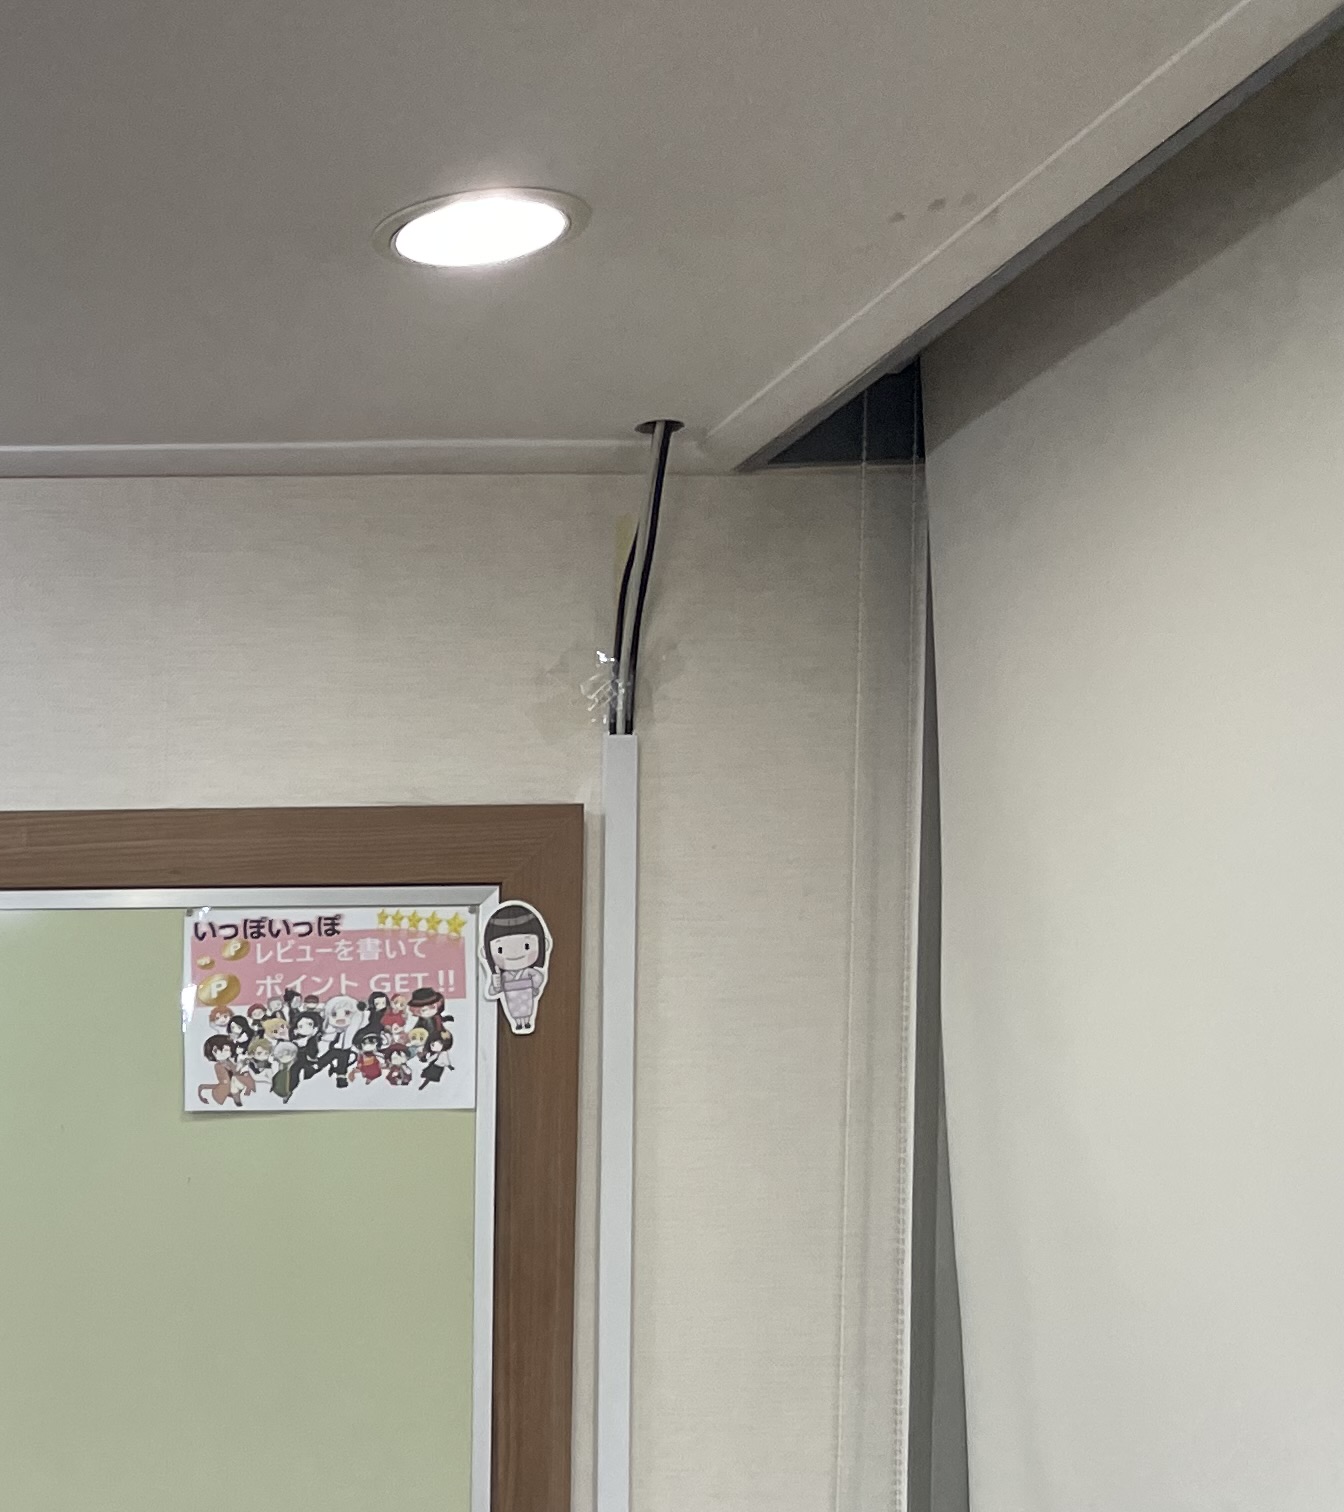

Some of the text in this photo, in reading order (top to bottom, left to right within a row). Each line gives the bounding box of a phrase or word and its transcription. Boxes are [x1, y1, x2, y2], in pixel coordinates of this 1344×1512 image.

[193, 913, 343, 941] いっぽいっぽ
[255, 937, 427, 964] レビューを書いて
[255, 972, 359, 998] ポイント
